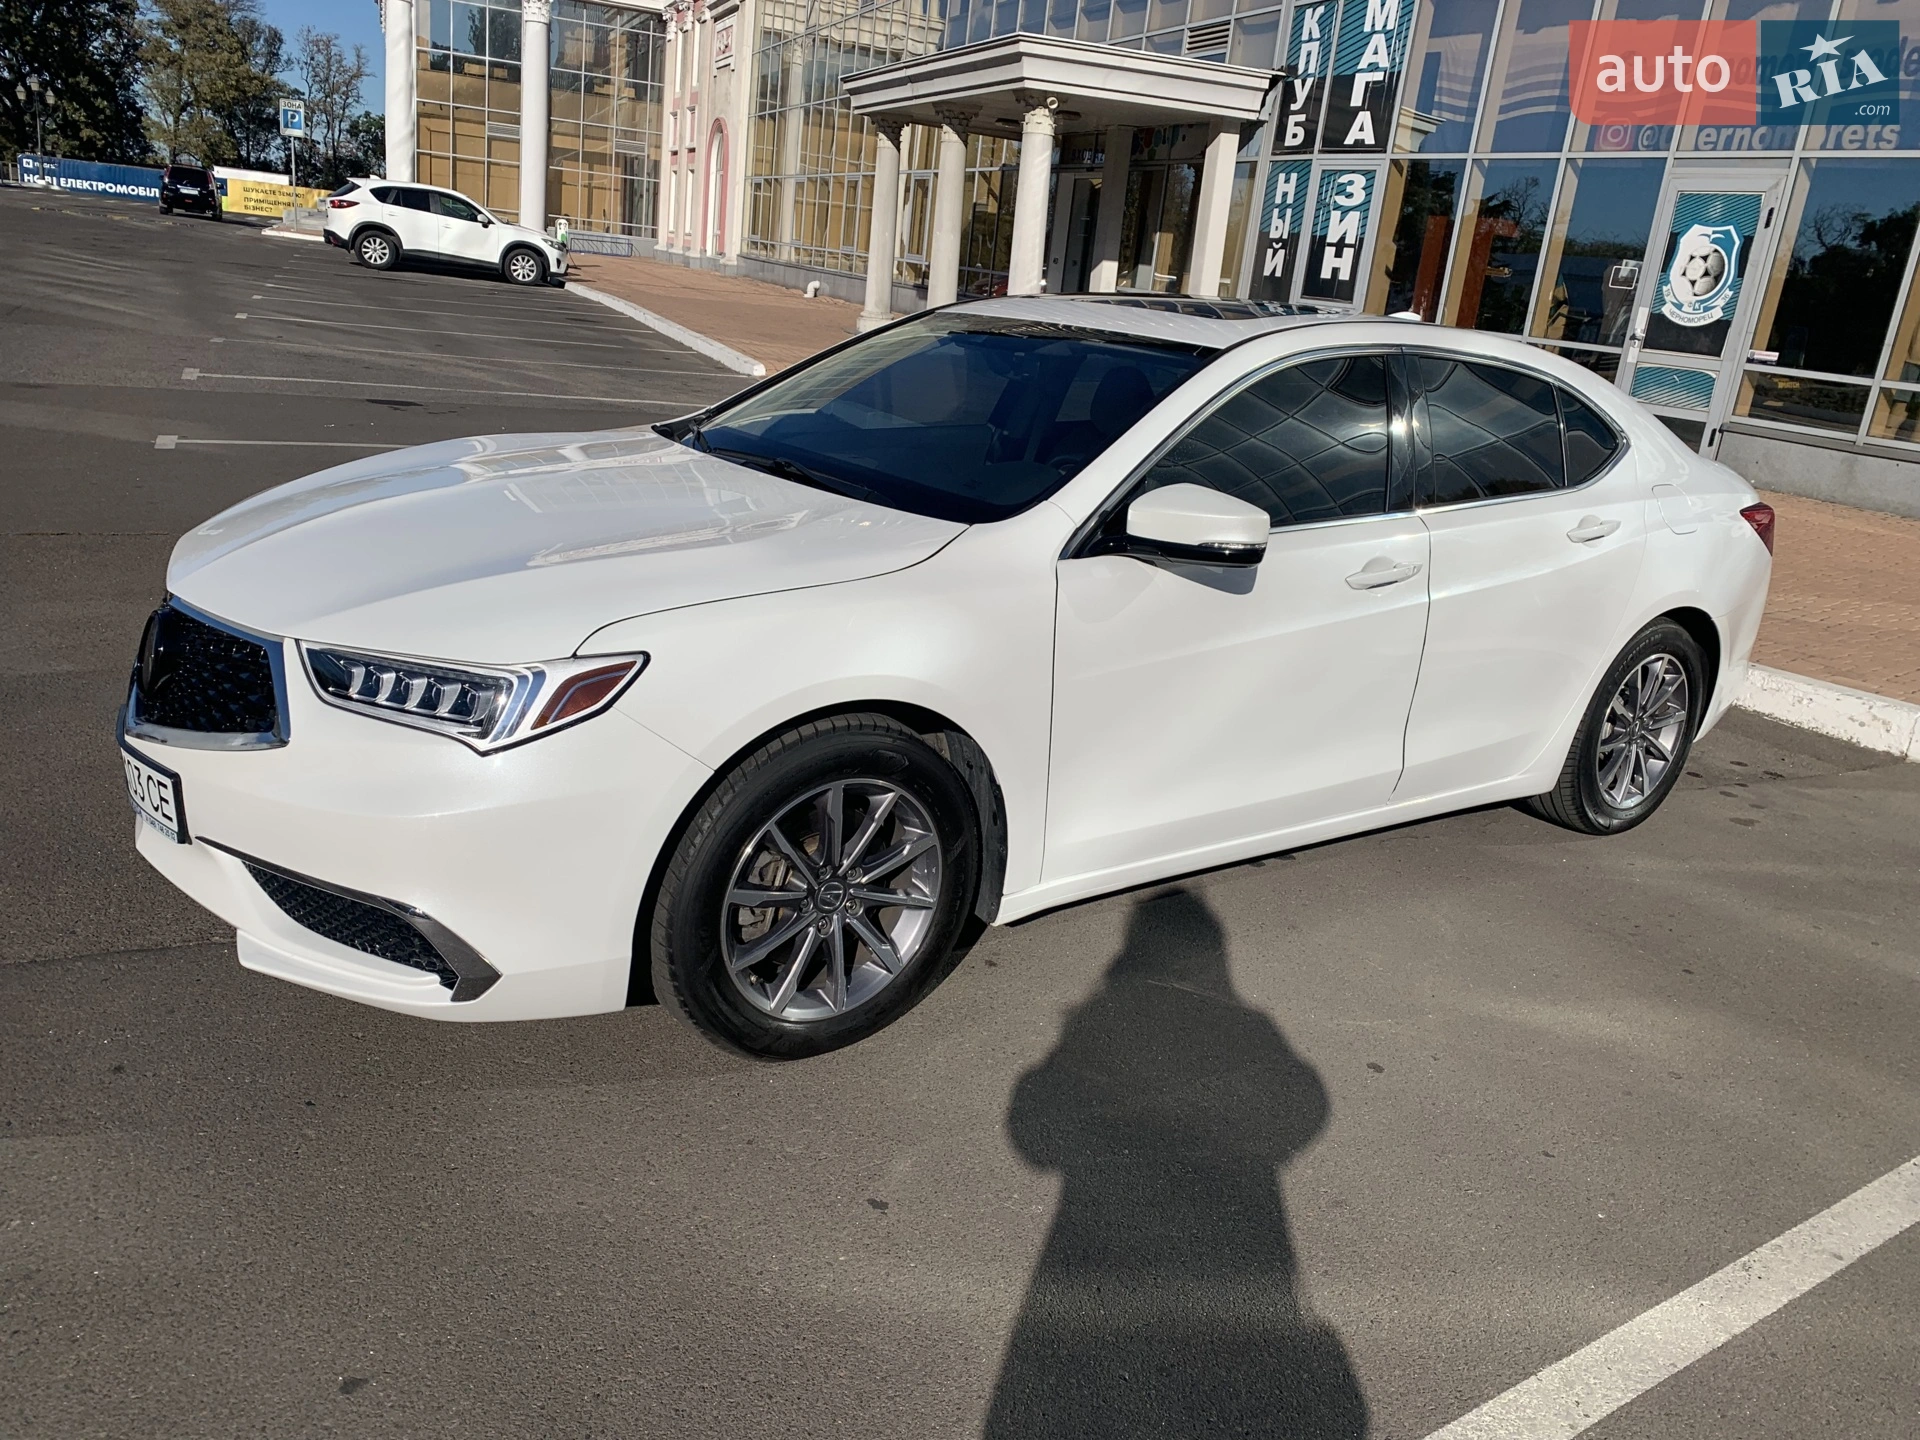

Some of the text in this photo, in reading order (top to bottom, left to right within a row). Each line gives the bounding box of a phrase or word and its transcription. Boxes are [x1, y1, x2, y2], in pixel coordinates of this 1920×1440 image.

[282, 100, 302, 109] ЗОНА
[243, 186, 277, 196] ШУКАЄТЕ
[243, 205, 273, 213] БІЗНЕС?
[1669, 308, 1714, 324] ЧЕРНОМОРЕЦ
[124, 757, 174, 823] 03 CE
